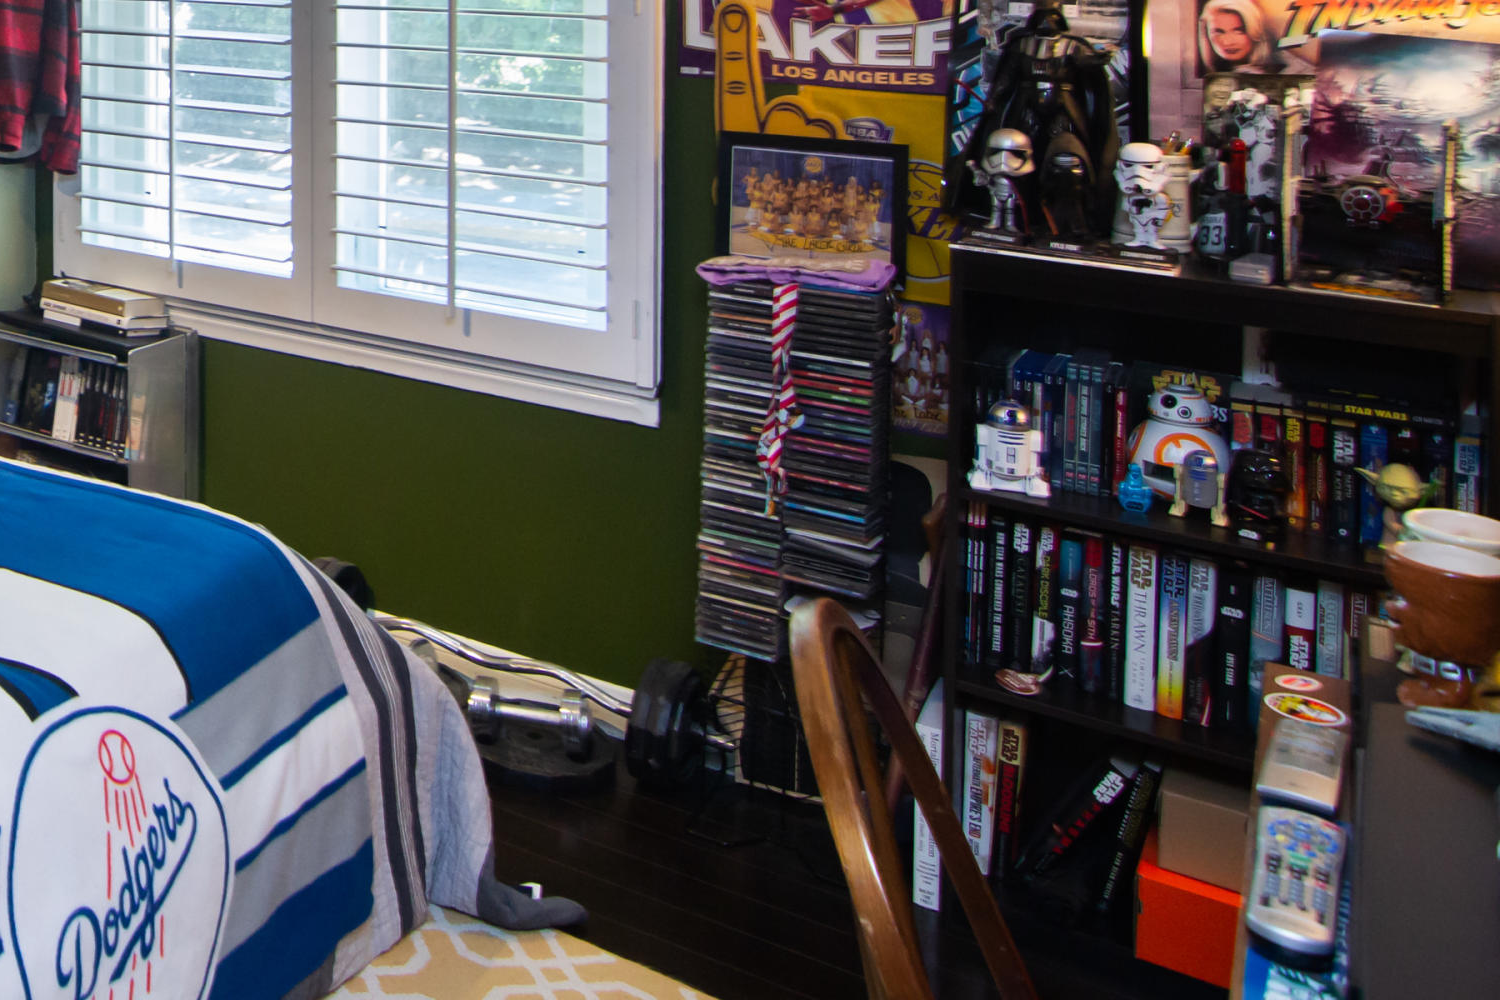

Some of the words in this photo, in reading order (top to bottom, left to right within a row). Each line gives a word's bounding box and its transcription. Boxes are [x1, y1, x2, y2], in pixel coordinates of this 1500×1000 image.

[771, 63, 819, 81] LOS
[822, 65, 936, 87] ANGELES
[1200, 225, 1223, 246] 33
[1344, 405, 1372, 417] STAR
[1373, 408, 1409, 421] WARS
[1333, 430, 1344, 464] WARS
[1343, 433, 1355, 465] STAR
[1041, 555, 1051, 580] DARK
[1111, 543, 1122, 575] STAR
[1130, 549, 1142, 589] WARS
[1141, 552, 1152, 590] STAR
[1088, 567, 1098, 598] LORDS
[1110, 576, 1121, 608] WARS
[1163, 558, 1175, 598] WARS
[1174, 559, 1186, 599] STAR
[1038, 580, 1049, 618] DISCIPLE
[1061, 604, 1075, 655] AHSOKA
[1086, 619, 1097, 640] SITH
[1109, 609, 1120, 650] TARKIN
[1133, 591, 1148, 653] THRAWN
[1226, 652, 1236, 667] LOST
[1289, 635, 1300, 668] WARS
[1299, 640, 1309, 670] STAR
[1324, 642, 1336, 671] ONE
[1224, 667, 1235, 686] STARS
[968, 719, 978, 755] WARS
[977, 722, 987, 755] STAR
[1009, 730, 1020, 761] STAR
[1092, 770, 1116, 804] WARS
[1102, 774, 1125, 805] STAR
[969, 787, 983, 822] EMPIRE'S
[968, 822, 982, 839] END
[56, 777, 197, 1000] Dodgers
